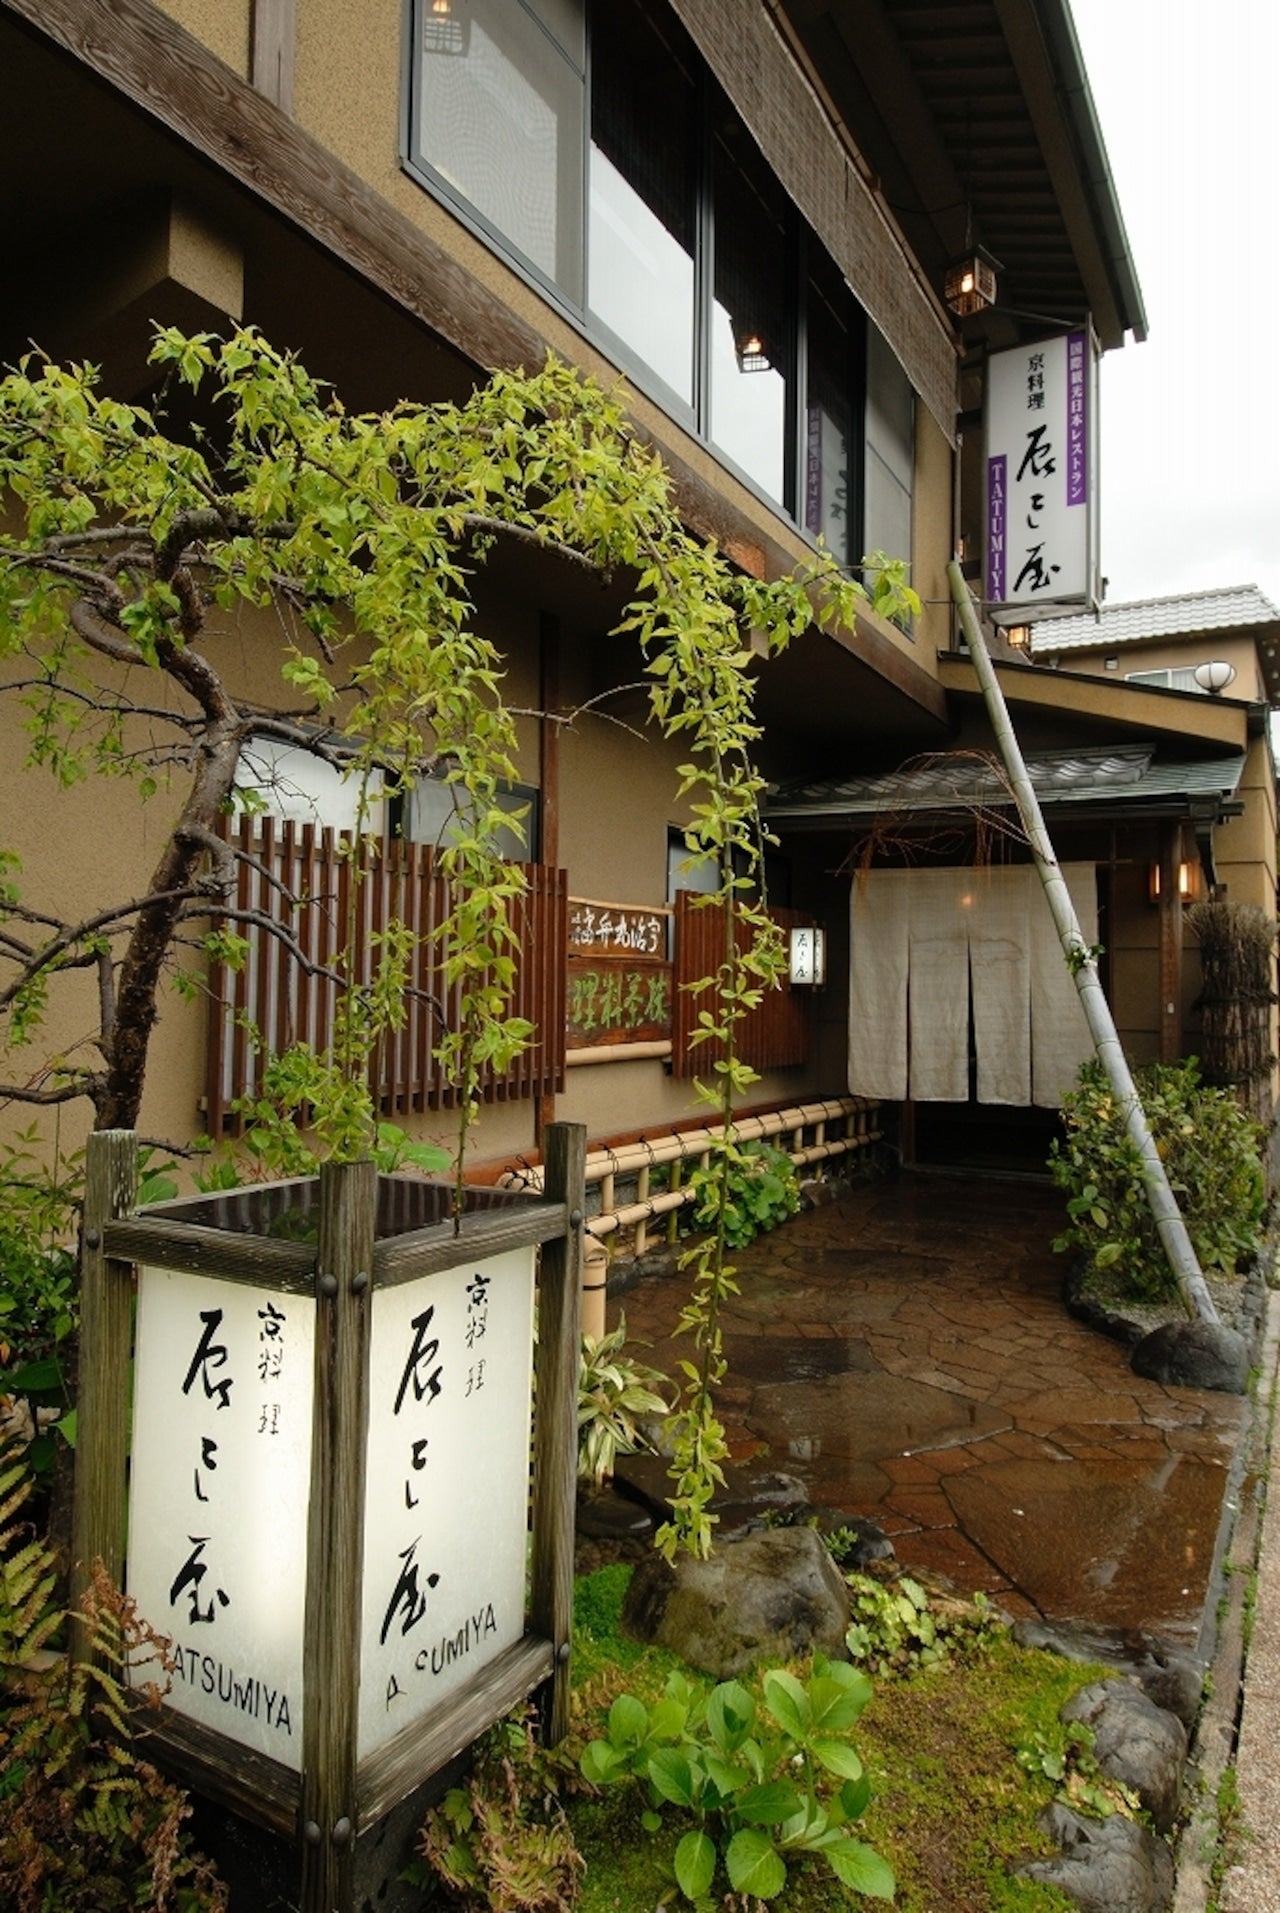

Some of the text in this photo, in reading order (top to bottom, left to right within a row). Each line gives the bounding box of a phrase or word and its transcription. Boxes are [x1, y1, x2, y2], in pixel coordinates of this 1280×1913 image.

[1027, 353, 1045, 411] 京料理
[990, 463, 1004, 602] TATUMIYA
[257, 1301, 287, 1435] 京料理
[464, 1273, 492, 1398] 京料理
[172, 1642, 293, 1736] ATSUMIYA
